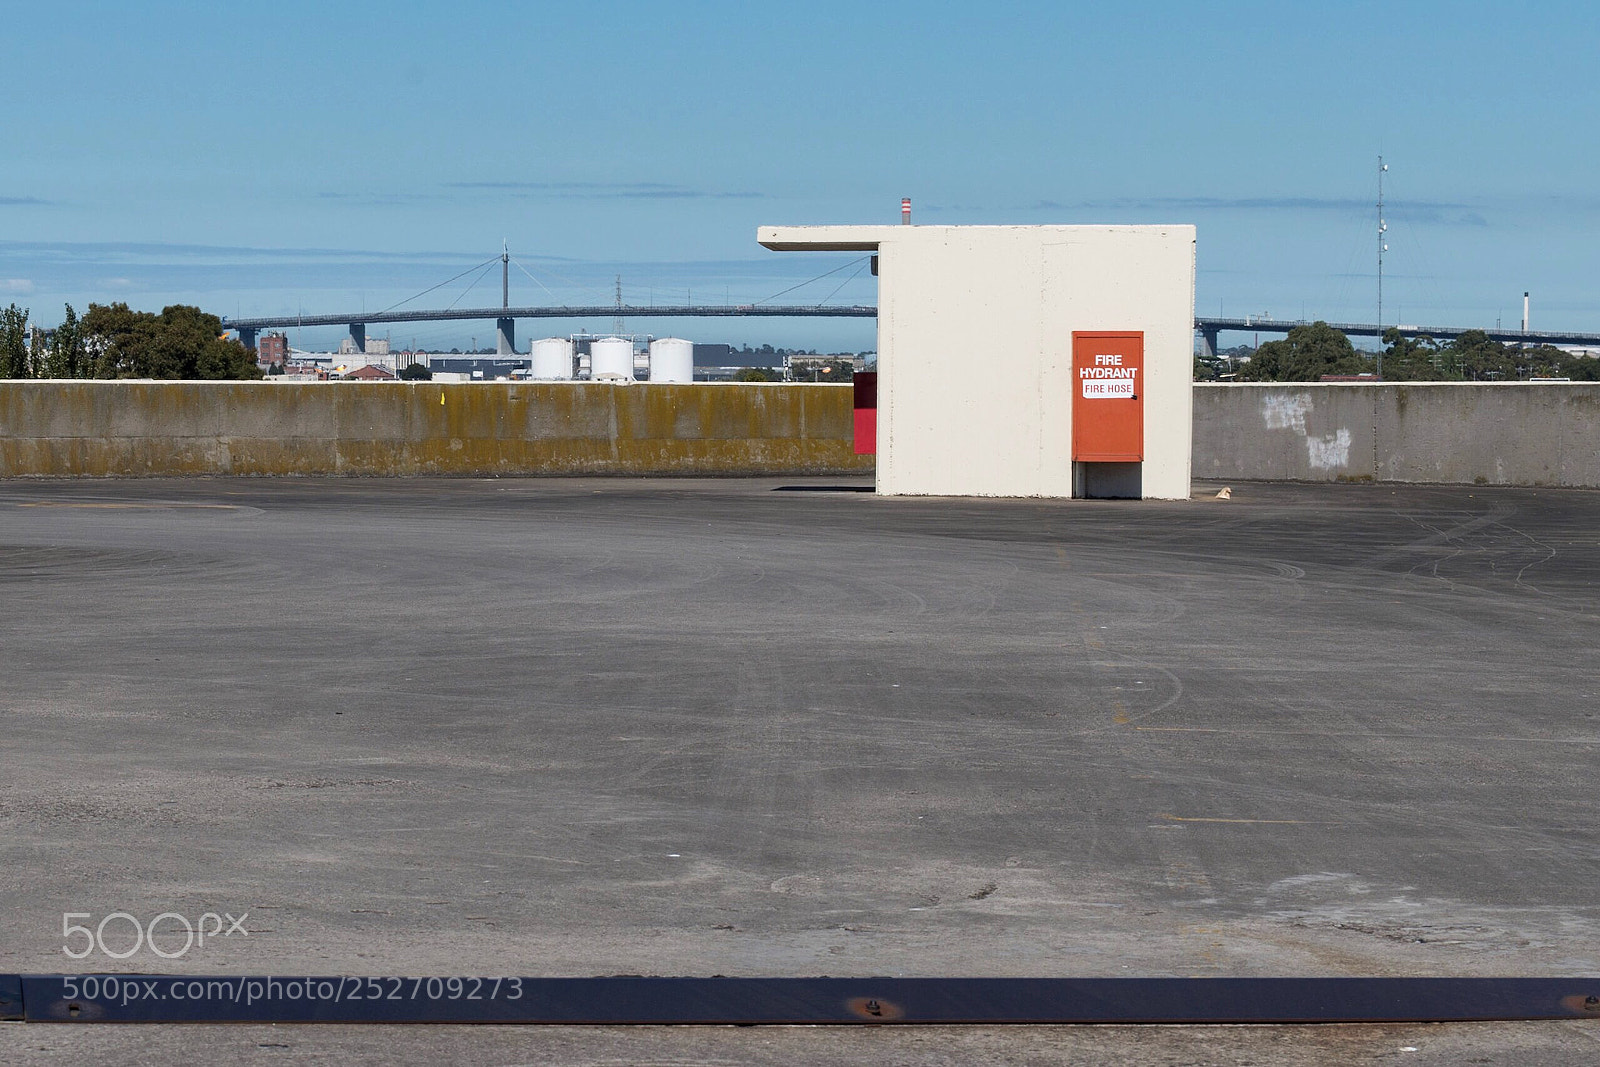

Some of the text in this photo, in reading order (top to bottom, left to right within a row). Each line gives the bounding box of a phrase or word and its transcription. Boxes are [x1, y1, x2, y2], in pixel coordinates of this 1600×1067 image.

[1095, 355, 1122, 366] FIRE
[1080, 368, 1138, 379] HYDRANT
[1085, 384, 1132, 393] FIRE HOSE
